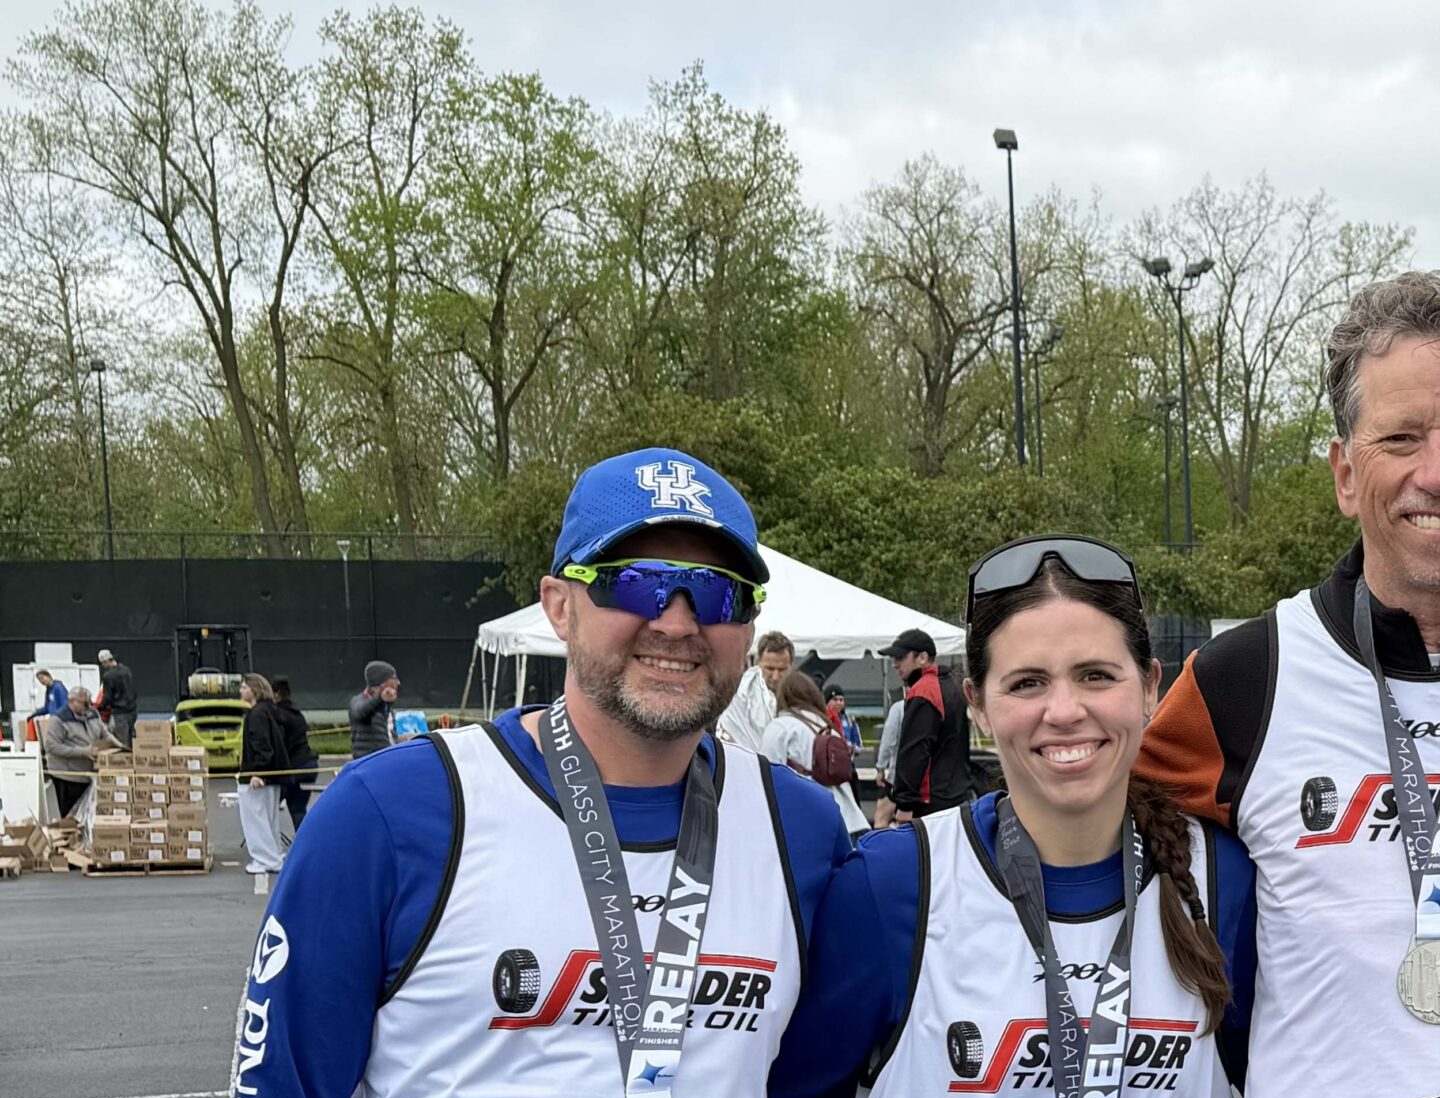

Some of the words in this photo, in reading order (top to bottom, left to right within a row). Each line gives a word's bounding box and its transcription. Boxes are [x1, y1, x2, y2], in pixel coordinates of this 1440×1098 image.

[635, 460, 714, 518] UK
[560, 755, 598, 823] GLASS
[585, 831, 615, 885] CITY
[643, 865, 711, 1030] RELAY
[580, 967, 772, 1010] SDER
[613, 1003, 627, 1043] 4.26.26
[639, 1037, 679, 1045] FINISHER
[704, 1010, 761, 1032] OIL
[1018, 1034, 1192, 1069] SDER
[1127, 1072, 1179, 1090] OIL
